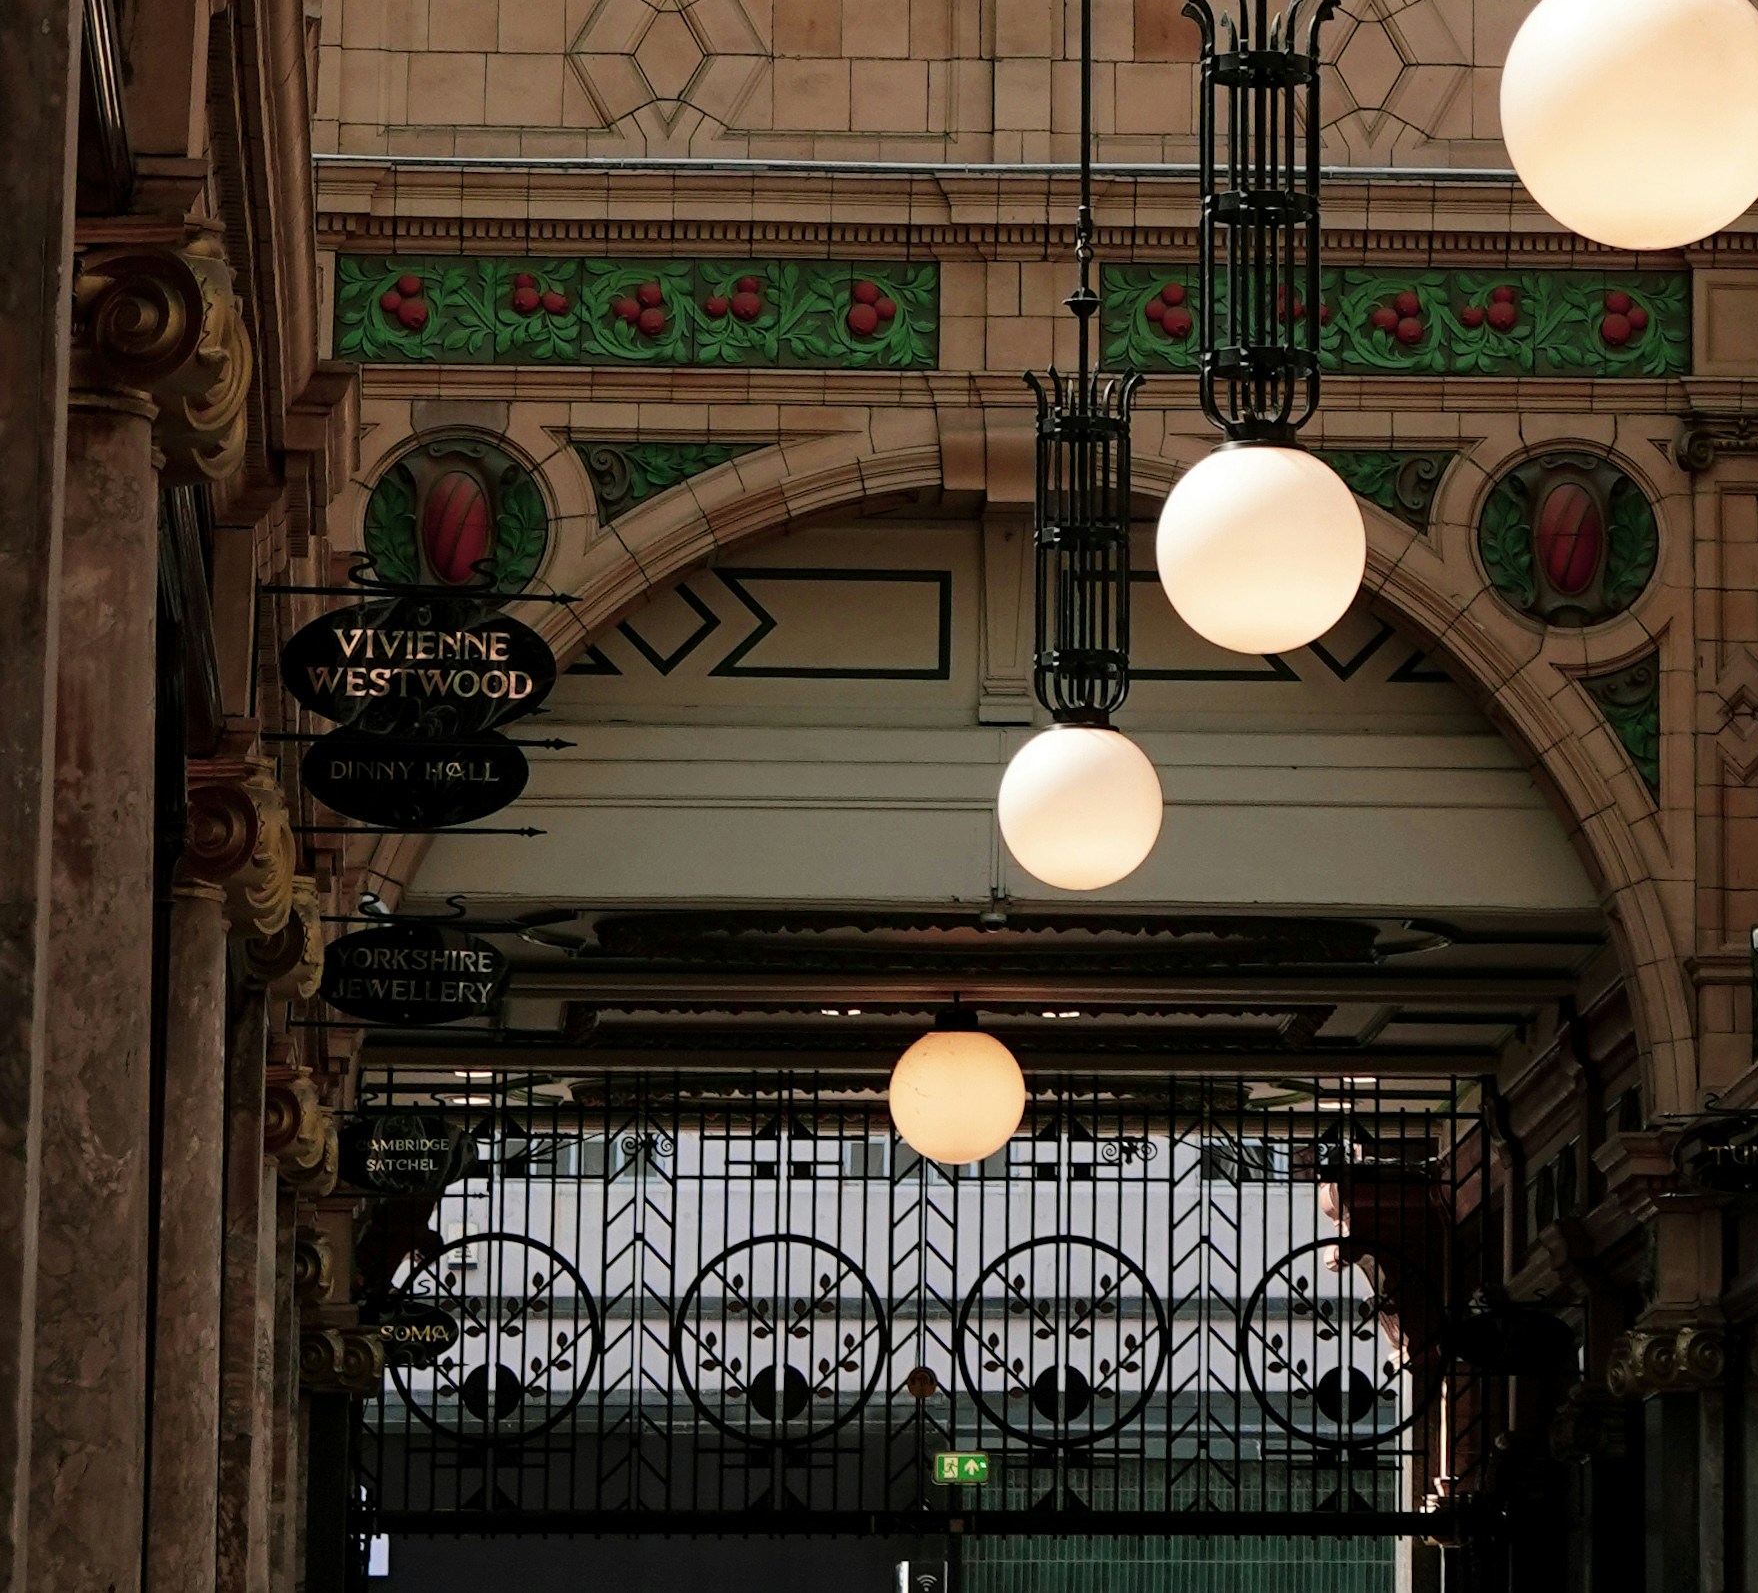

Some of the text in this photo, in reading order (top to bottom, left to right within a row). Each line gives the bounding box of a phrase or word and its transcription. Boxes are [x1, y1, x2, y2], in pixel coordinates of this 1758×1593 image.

[333, 628, 512, 663] VIVIENNE
[306, 666, 535, 700] WESTWOOD
[329, 760, 500, 783] DINNY HALL
[335, 947, 495, 974] YORKSHIRE
[331, 978, 493, 1003] JEWELLERY
[356, 1138, 450, 1152] CAMBRIDGE
[366, 1157, 439, 1172] SATCHEL
[379, 1324, 451, 1343] SOMA
